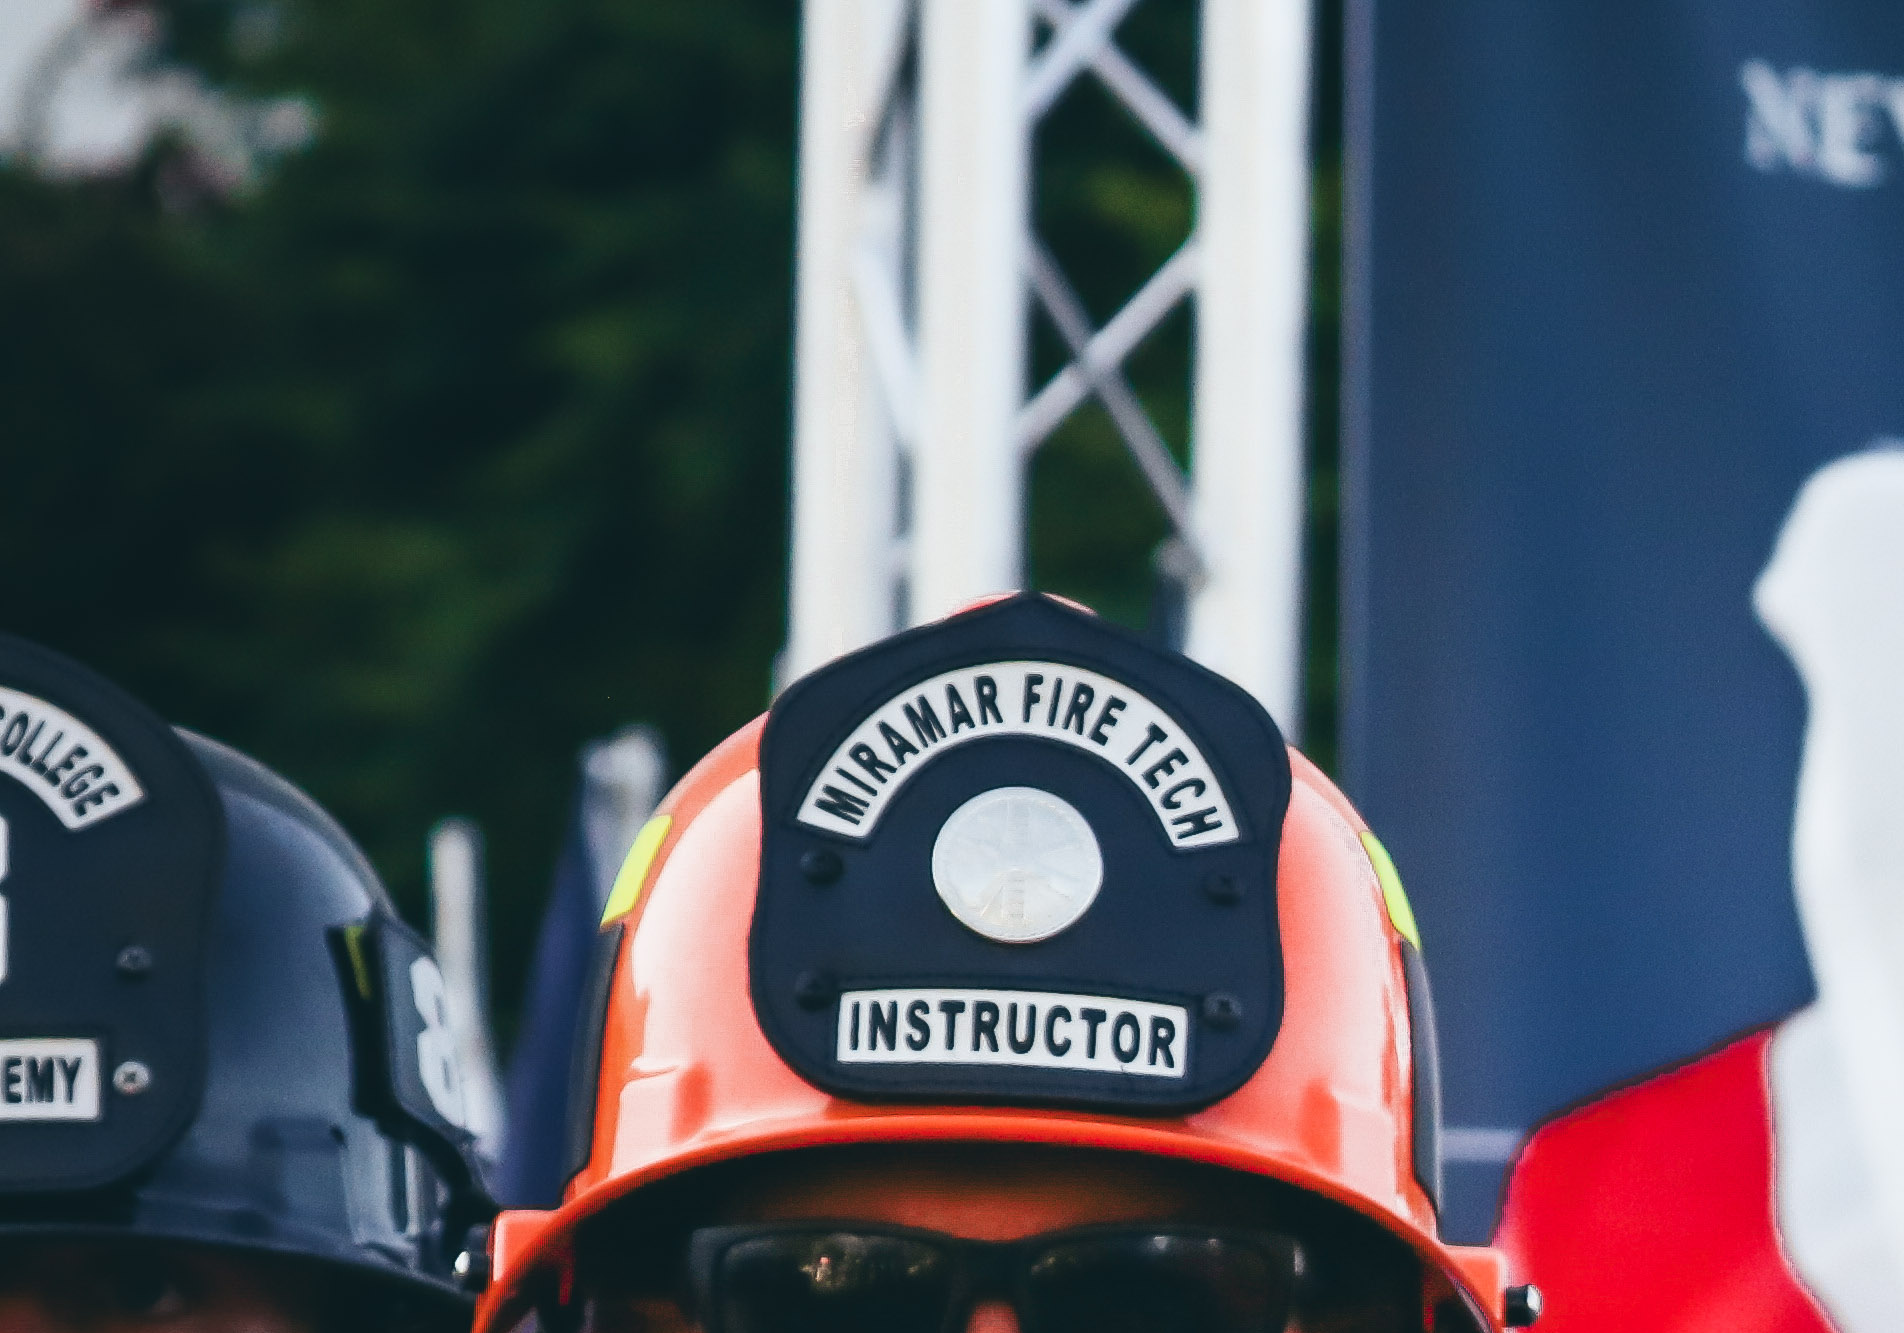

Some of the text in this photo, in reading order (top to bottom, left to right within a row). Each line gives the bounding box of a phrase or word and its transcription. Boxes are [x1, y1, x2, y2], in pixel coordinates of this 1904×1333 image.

[815, 674, 1222, 841] MIRAMAR FIRE TECH
[849, 1000, 1177, 1069] INSTRUCTOR
